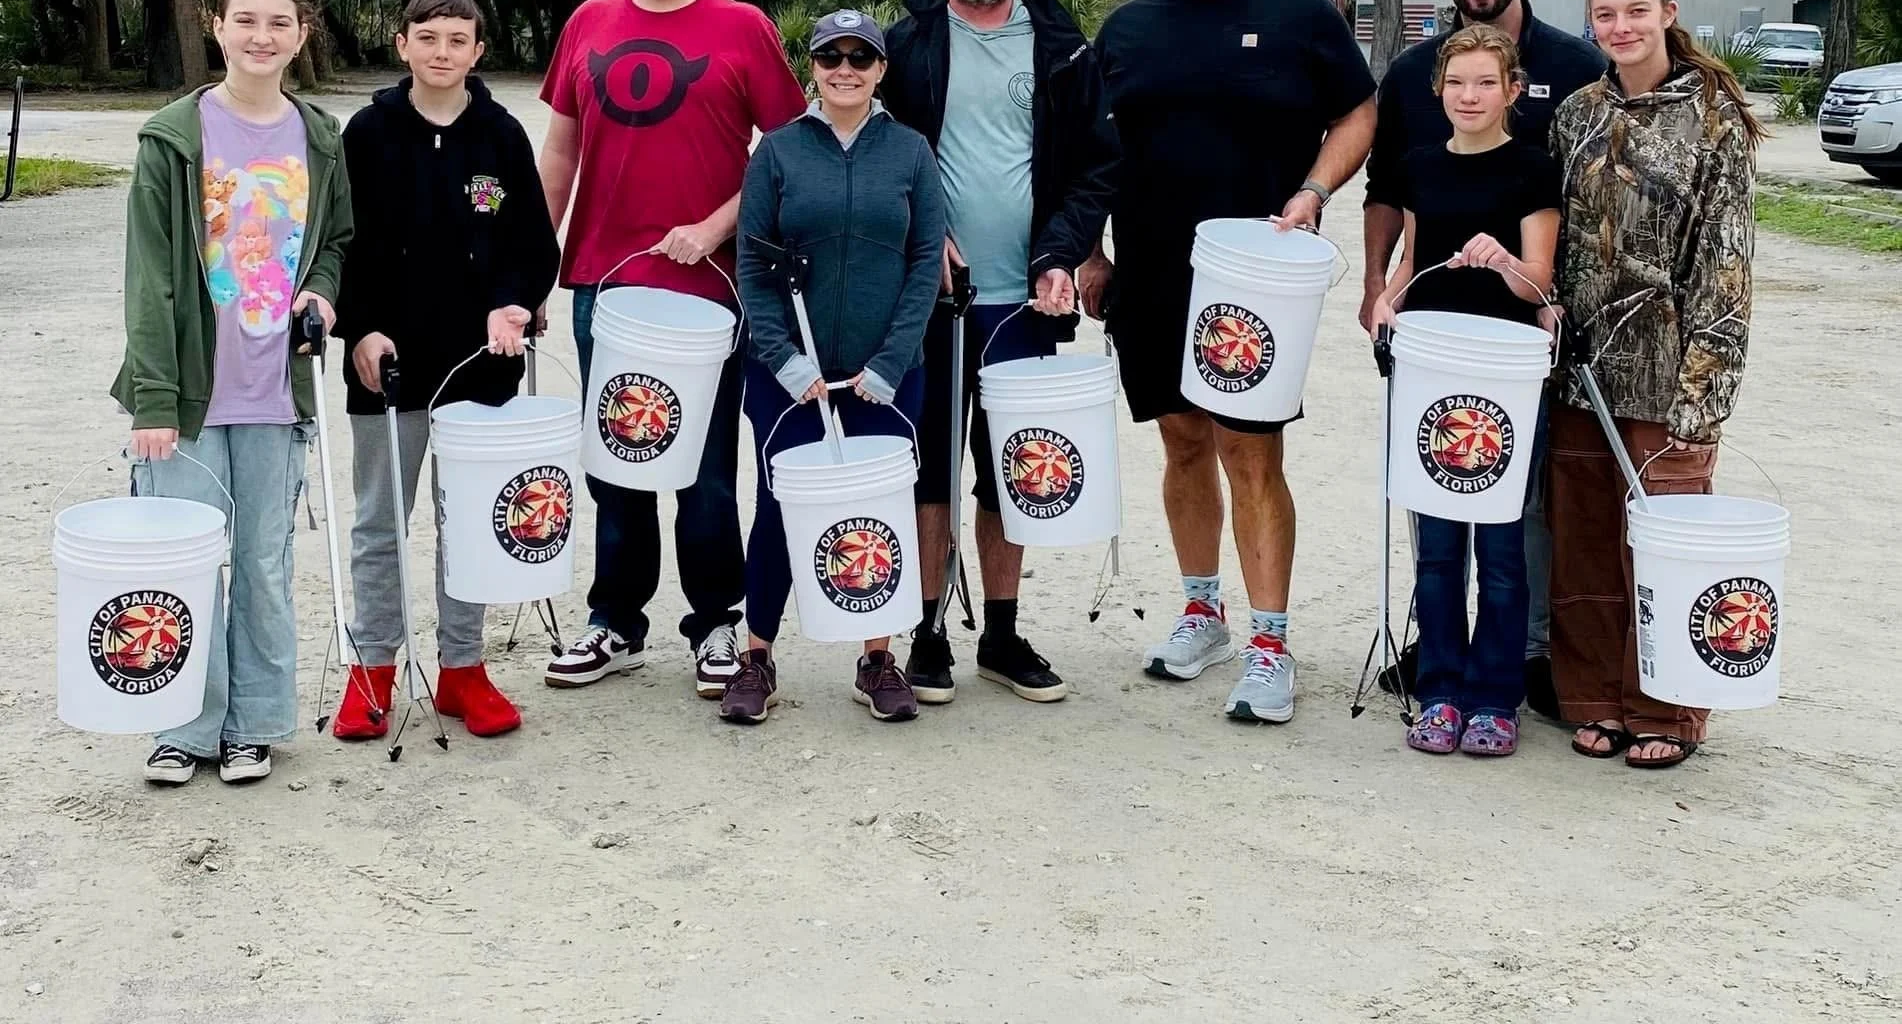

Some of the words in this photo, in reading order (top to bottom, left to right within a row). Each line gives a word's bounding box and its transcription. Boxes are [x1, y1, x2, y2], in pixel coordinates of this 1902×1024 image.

[1194, 318, 1205, 345] CITY
[1204, 306, 1217, 320] OF
[1220, 305, 1269, 339] PANAMA
[1260, 341, 1273, 370] CITY
[1199, 363, 1250, 391] FLORIDA
[599, 390, 609, 419] CITY
[608, 377, 622, 392] OF
[625, 375, 675, 404] PANAMA
[668, 405, 680, 434] CITY
[1419, 420, 1431, 454] CITY
[1427, 403, 1443, 421] OF
[1445, 397, 1505, 424] PANAMA
[1501, 424, 1512, 455] CITY
[605, 437, 660, 461] FLORIDA
[1006, 436, 1018, 452] OF
[1019, 430, 1072, 454] PANAMA
[1069, 455, 1082, 484] CITY
[495, 498, 507, 531] CITY
[504, 478, 520, 498] OF
[523, 468, 568, 488] PANAMA
[1434, 470, 1498, 492] FLORIDA
[1016, 499, 1071, 517] FLORIDA
[511, 539, 564, 562] FLORIDA
[815, 548, 827, 580] CITY
[821, 530, 836, 547] OF
[837, 519, 891, 540] PANAMA
[888, 539, 900, 570] CITY
[834, 589, 891, 611] FLORIDA
[1691, 607, 1705, 641] CITY
[1700, 588, 1718, 607] OF
[1720, 579, 1773, 603] PANAMA
[1769, 603, 1777, 634] CITY
[90, 621, 104, 657] CITY
[100, 602, 118, 621] OF
[121, 592, 183, 616] PANAMA
[180, 615, 191, 647] CITY
[107, 668, 176, 693] FLORIDA
[1710, 654, 1768, 676] FLORIDA
